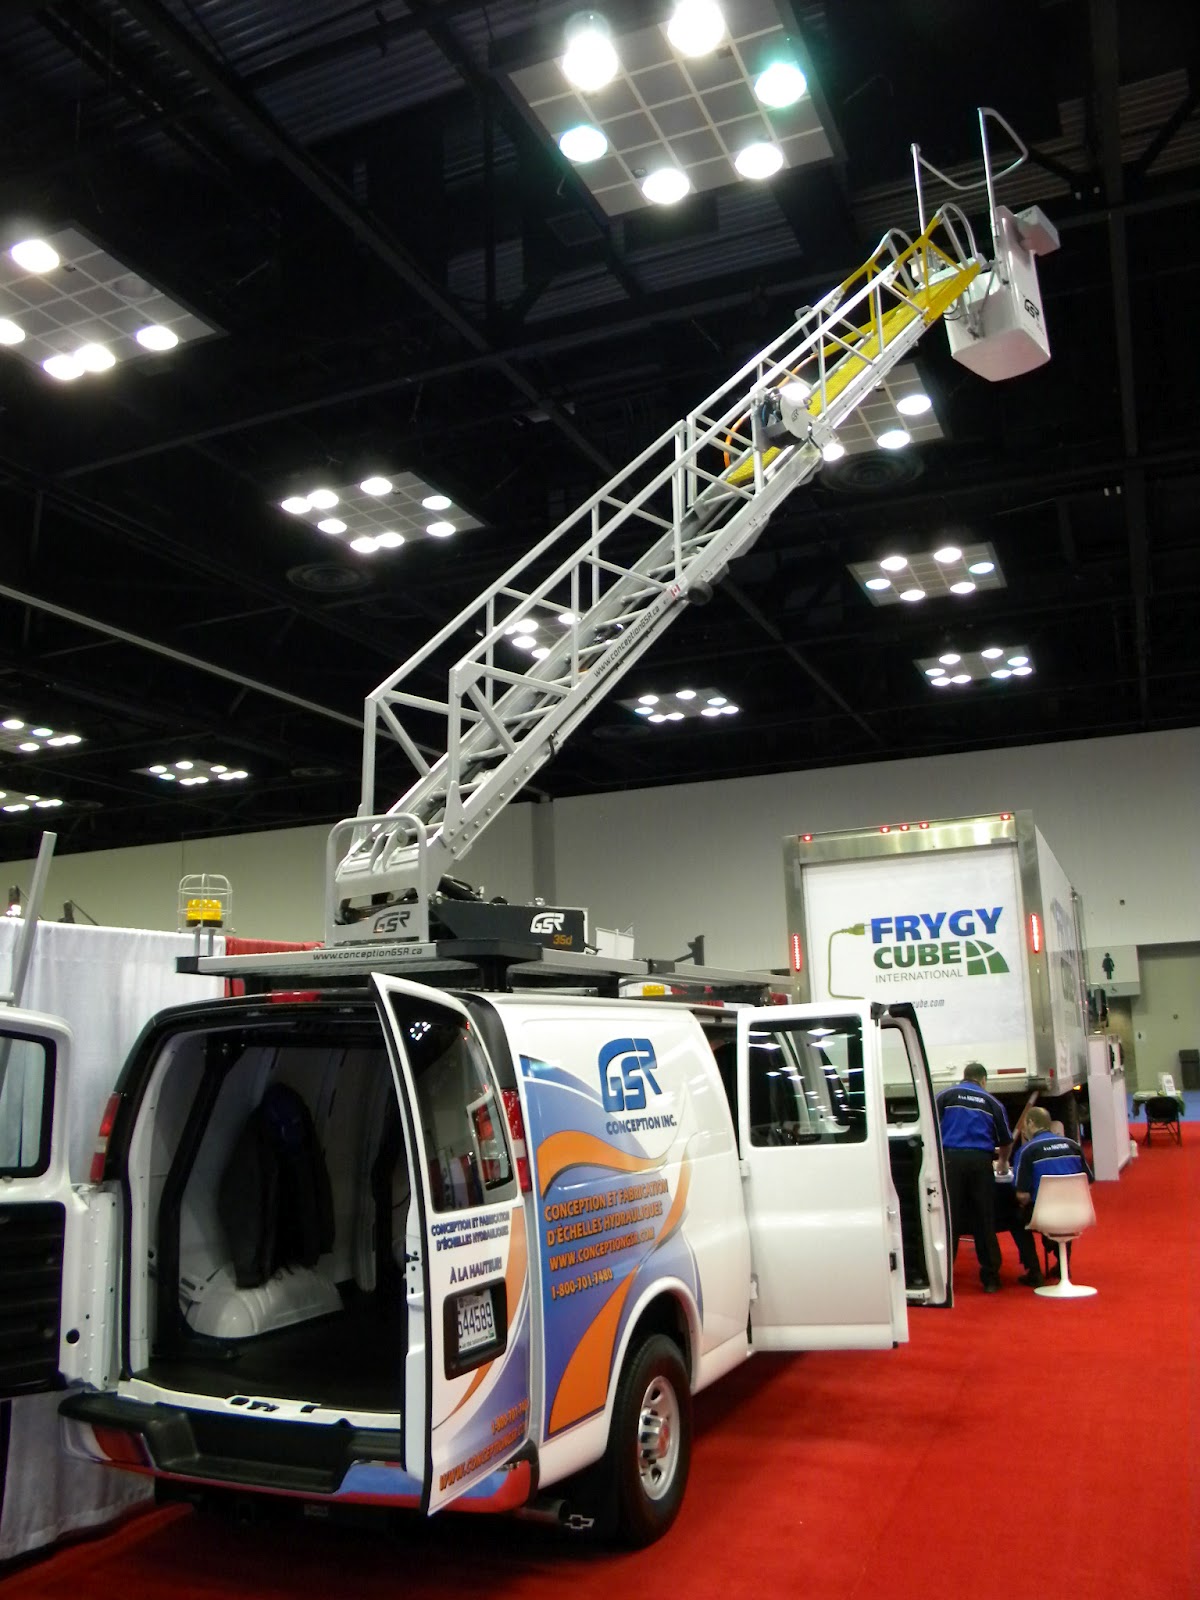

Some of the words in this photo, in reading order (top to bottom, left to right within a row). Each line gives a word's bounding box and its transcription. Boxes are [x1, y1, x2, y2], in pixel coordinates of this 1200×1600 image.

[373, 911, 410, 933] GSR
[530, 912, 565, 934] GSR
[870, 906, 1004, 943] FRYGY
[873, 940, 962, 970] CUBE
[875, 968, 964, 983] INTERNATIONAL
[598, 1037, 662, 1112] GSR
[606, 1116, 660, 1135] CONCEPTION
[661, 1114, 677, 1128] INC.
[544, 1195, 606, 1222] CONCEPTION
[607, 1190, 618, 1208] ET
[618, 1178, 668, 1204] FABRICATION
[546, 1217, 603, 1247] D'ÉCHELLES
[604, 1201, 663, 1231] HYDRAULIQUES
[549, 1226, 655, 1271] WWW.CONCEPTIONGSR.COM
[449, 1265, 457, 1284] À
[458, 1266, 469, 1282] LA
[551, 1267, 613, 1301] 1-800-701-7480
